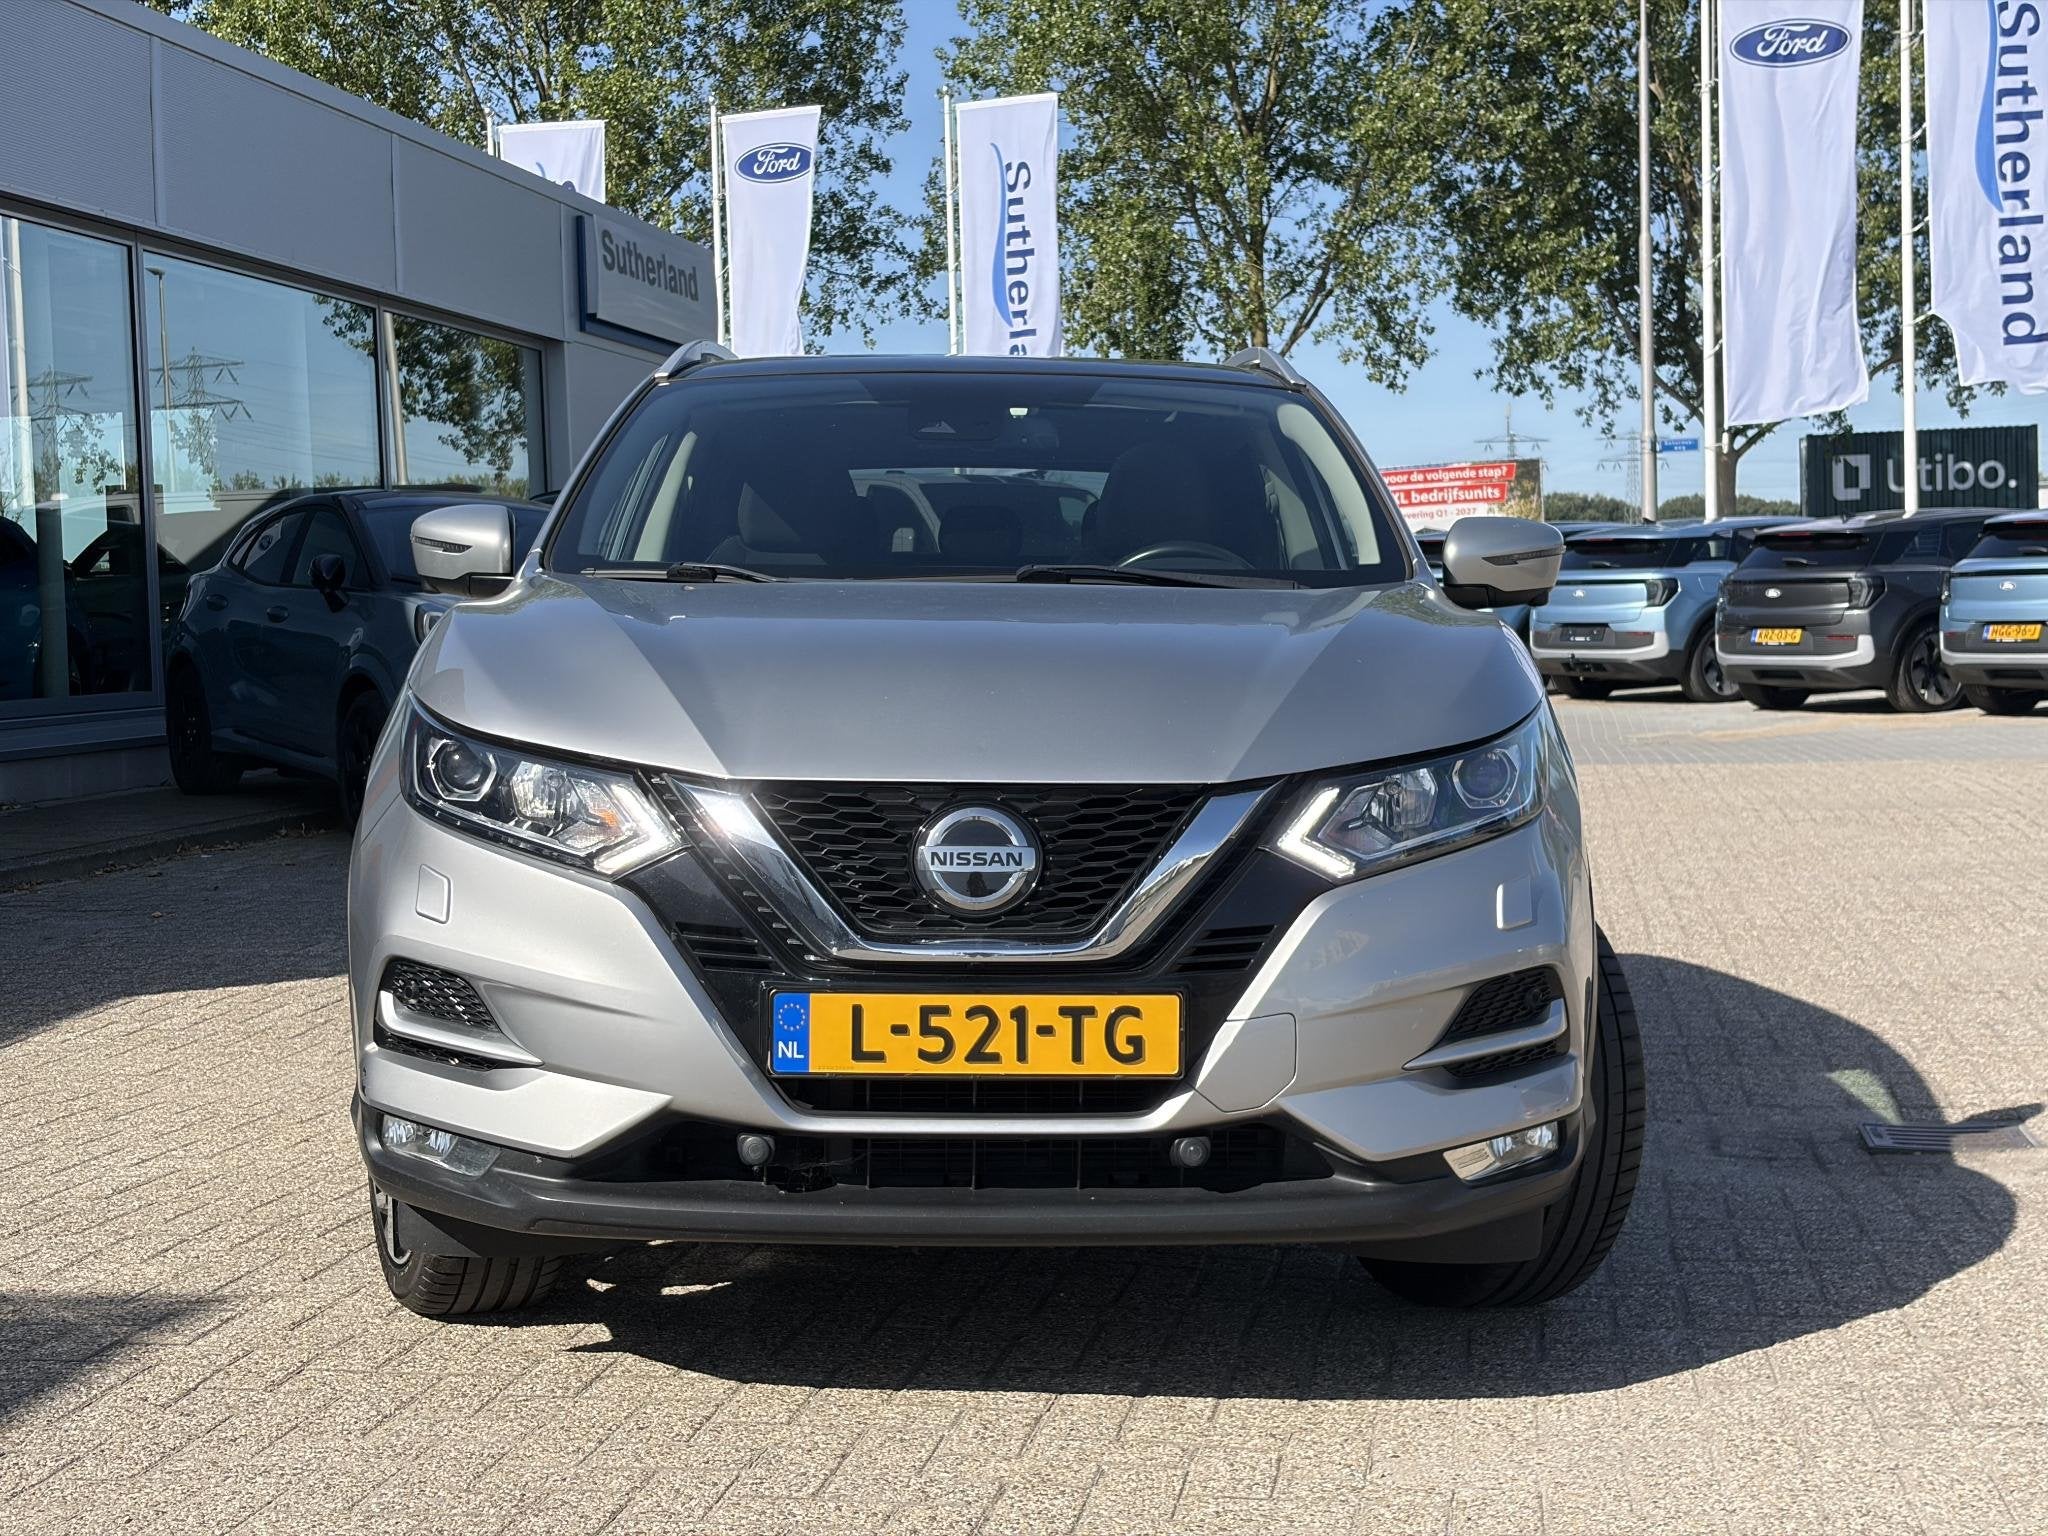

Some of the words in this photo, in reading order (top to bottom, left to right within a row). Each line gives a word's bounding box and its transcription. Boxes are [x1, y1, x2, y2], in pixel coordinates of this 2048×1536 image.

[1757, 24, 1829, 57] Ford
[753, 147, 801, 175] Ford
[1996, 1, 2048, 346] Sutherland
[601, 229, 699, 302] Sutherland
[1410, 471, 1424, 482] de
[1425, 468, 1477, 481] volgende
[1478, 465, 1508, 479] stap?
[1411, 486, 1501, 504] bedrijfsunits
[930, 851, 1023, 867] NISSAN
[851, 1003, 1147, 1065] L-521-TG
[778, 1041, 805, 1059] NL
